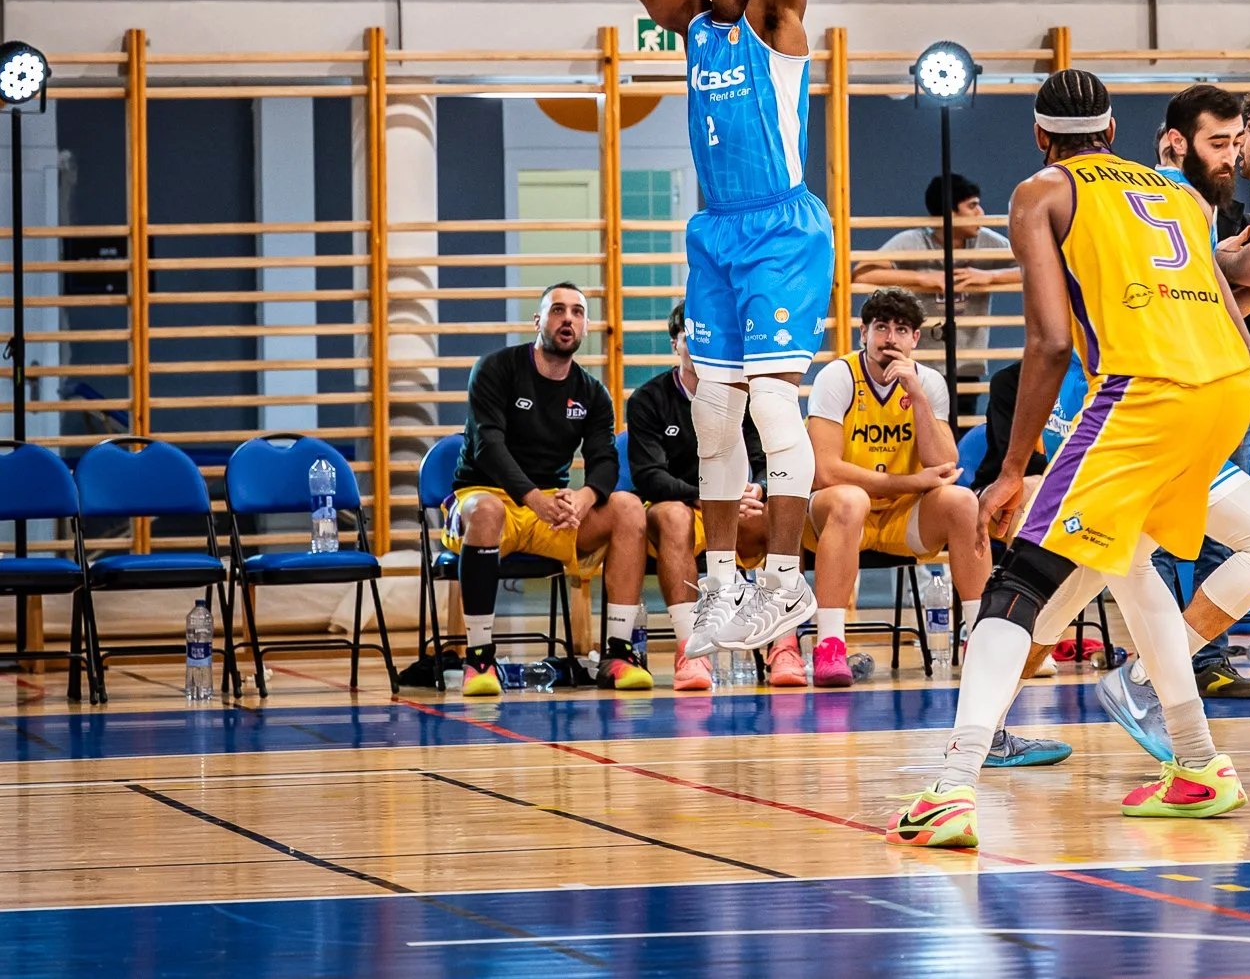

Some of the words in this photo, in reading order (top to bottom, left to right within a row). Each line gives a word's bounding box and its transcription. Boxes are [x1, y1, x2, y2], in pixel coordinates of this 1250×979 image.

[709, 91, 729, 102] Rent
[736, 87, 752, 97] car
[706, 115, 720, 147] 2
[1123, 190, 1190, 270] 5
[1157, 283, 1220, 304] Romau
[851, 422, 913, 444] HOMS
[868, 445, 897, 453] RENTALS
